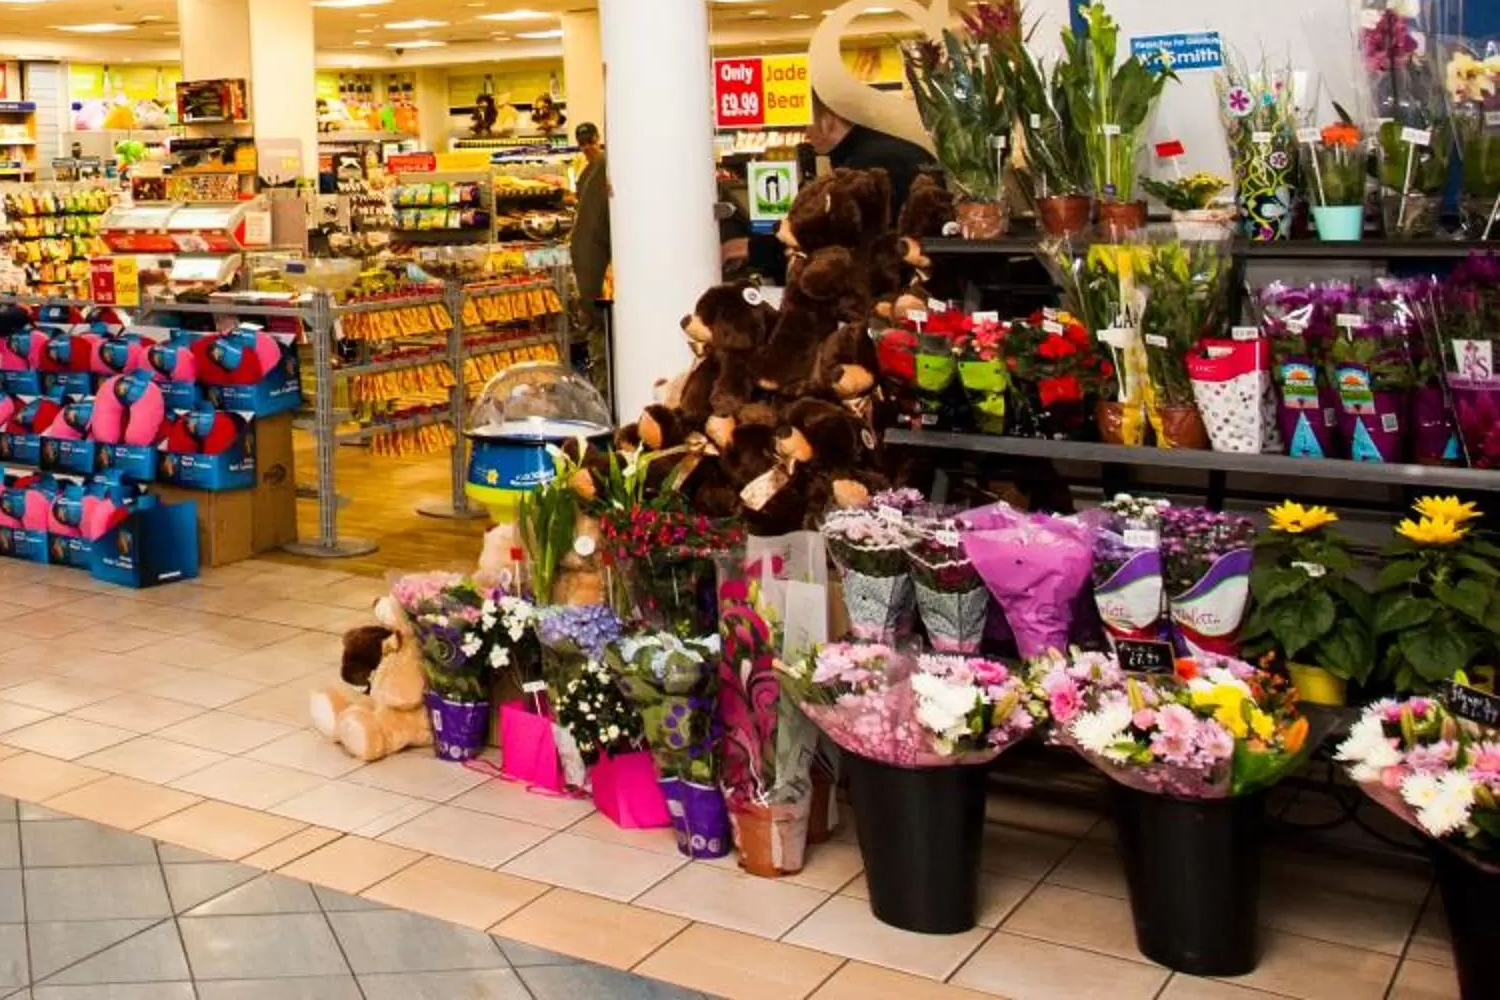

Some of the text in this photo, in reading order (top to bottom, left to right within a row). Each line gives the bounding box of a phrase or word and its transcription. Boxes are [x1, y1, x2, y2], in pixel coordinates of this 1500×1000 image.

[721, 64, 754, 85] Only
[765, 64, 807, 83] Jade
[721, 92, 759, 117] £9.99
[767, 91, 805, 110] Bear
